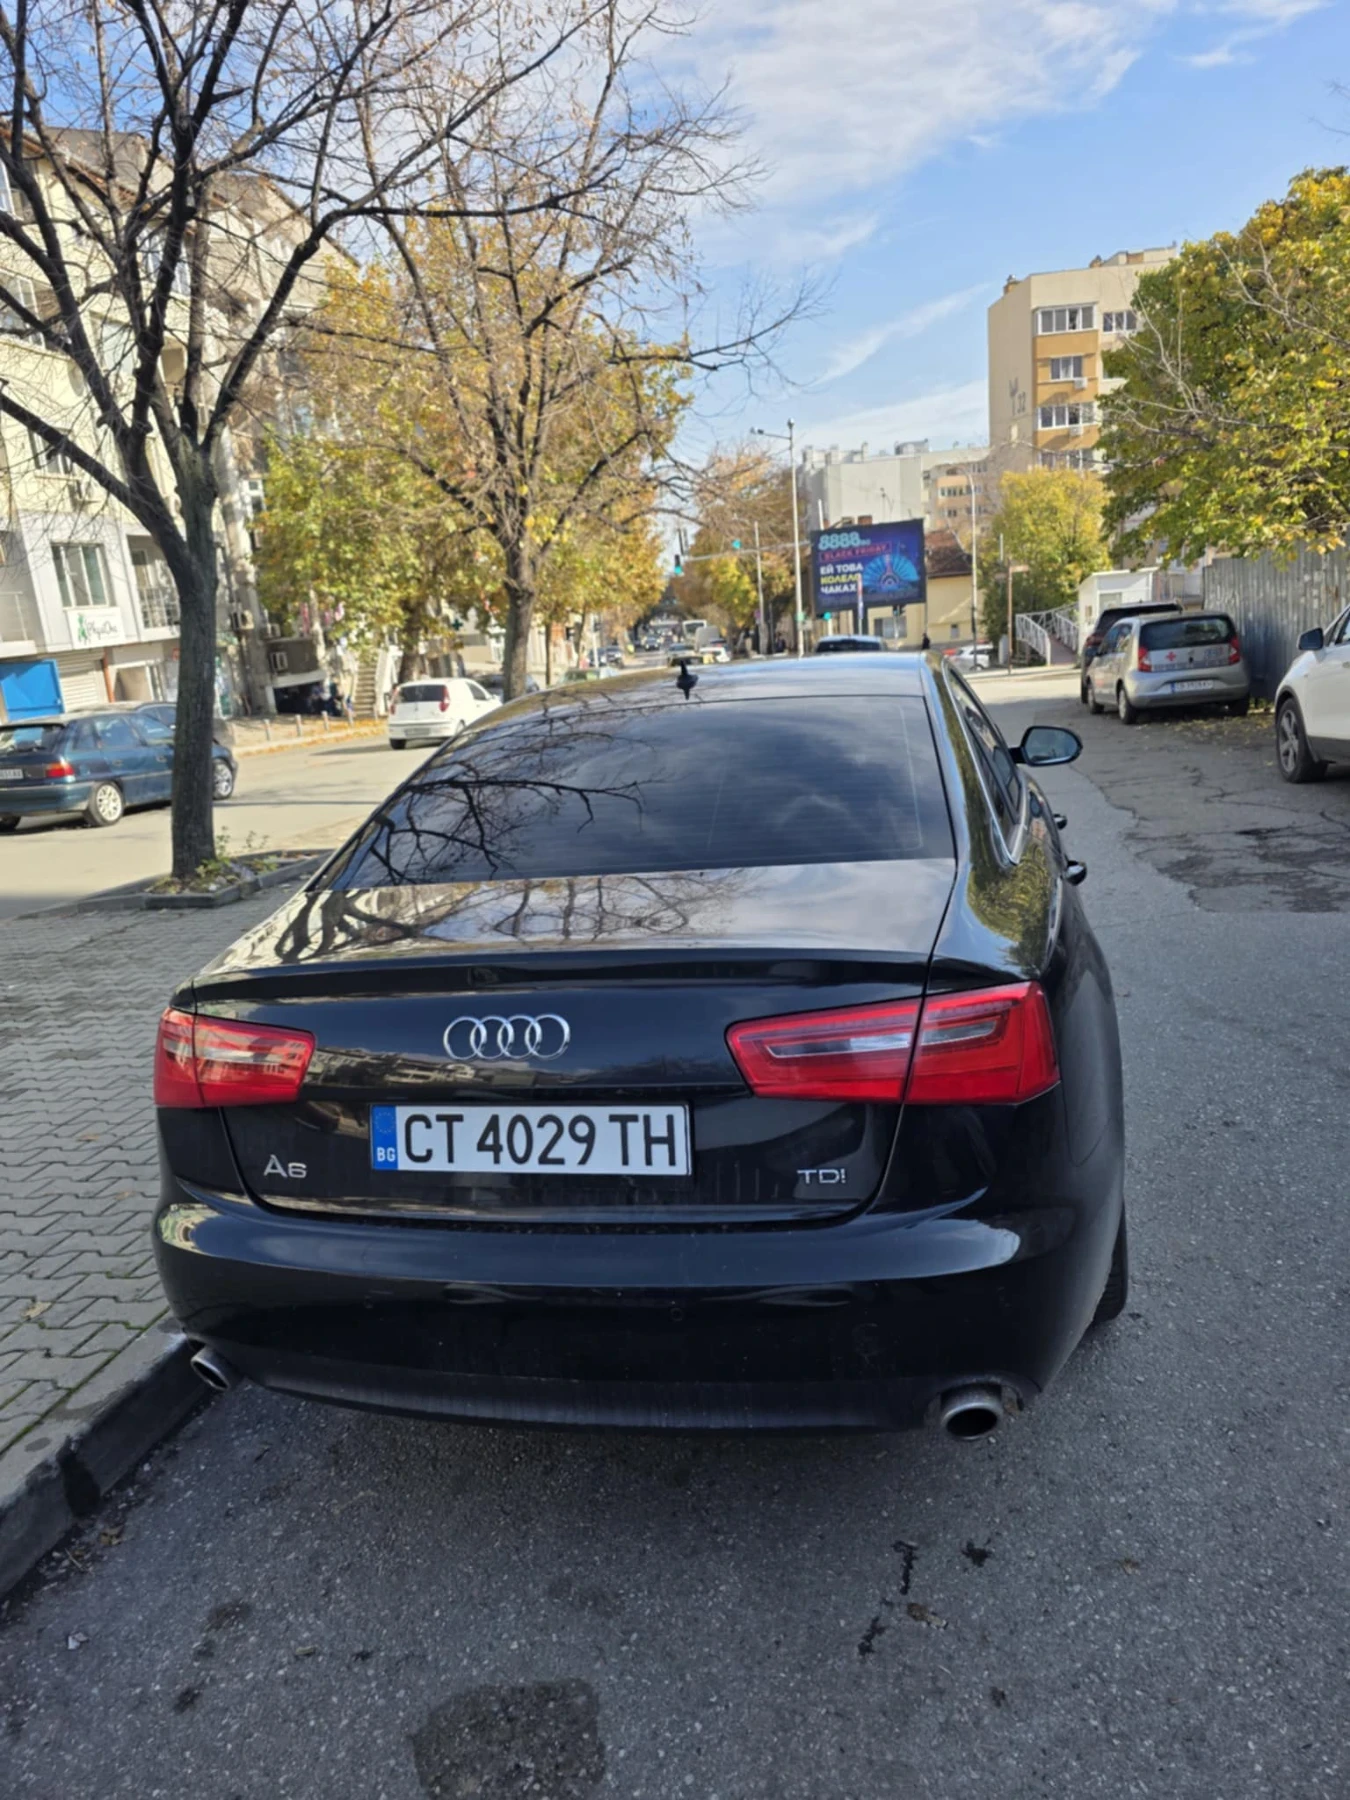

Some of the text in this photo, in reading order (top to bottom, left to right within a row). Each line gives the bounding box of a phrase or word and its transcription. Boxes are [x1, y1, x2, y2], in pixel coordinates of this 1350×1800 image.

[820, 562, 864, 574] ЕЙ ТОВА
[820, 584, 857, 594] ЧАКАХ
[404, 1113, 677, 1167] CT 4029 TH
[376, 1147, 396, 1163] BG
[263, 1154, 307, 1178] A6
[796, 1168, 846, 1184] TDI
